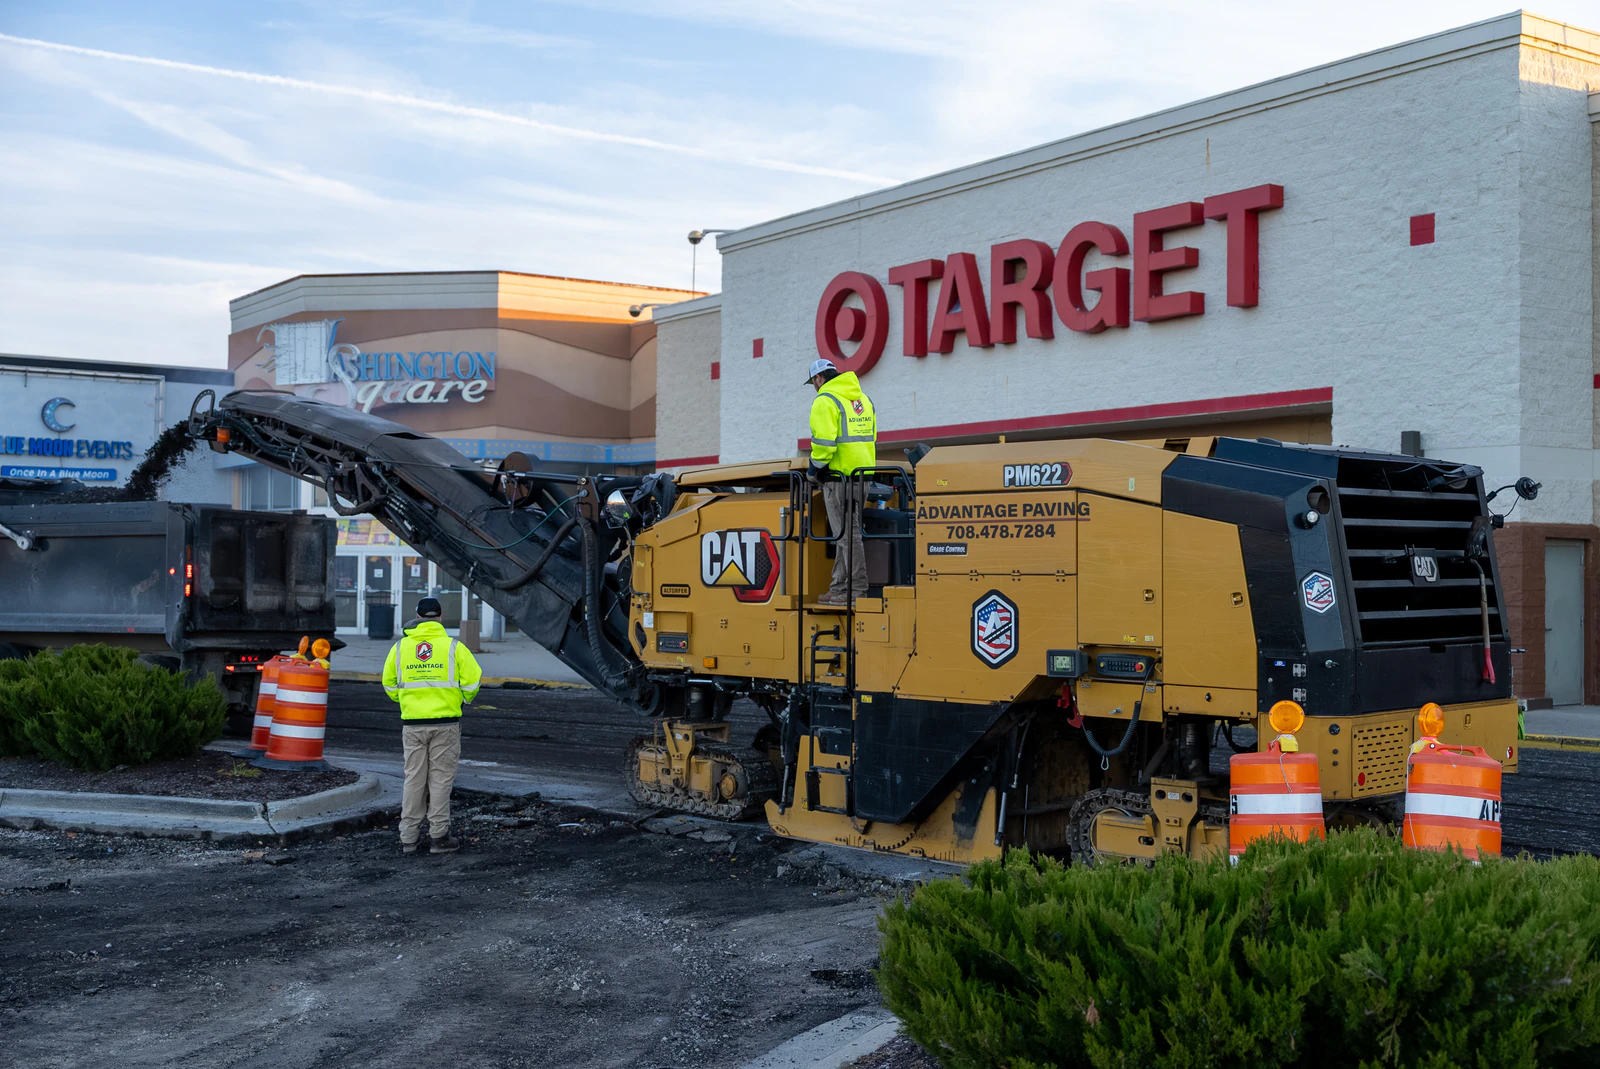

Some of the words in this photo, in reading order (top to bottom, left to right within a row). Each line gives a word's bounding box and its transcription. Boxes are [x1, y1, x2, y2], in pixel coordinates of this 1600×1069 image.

[889, 183, 1284, 357] TARGET
[29, 437, 74, 457] MOON
[77, 440, 133, 460] EVENTS
[9, 467, 35, 477] Once
[37, 469, 47, 478] In
[48, 469, 56, 478] A
[59, 469, 80, 479] Blue
[82, 470, 110, 479] Moon
[1004, 463, 1062, 487] PM622
[917, 503, 1018, 520] ADVANTAGE
[1022, 502, 1091, 517] PAVING
[946, 523, 1056, 539] 708.478.7284
[702, 531, 761, 586] CAT
[1414, 556, 1432, 576] CAT
